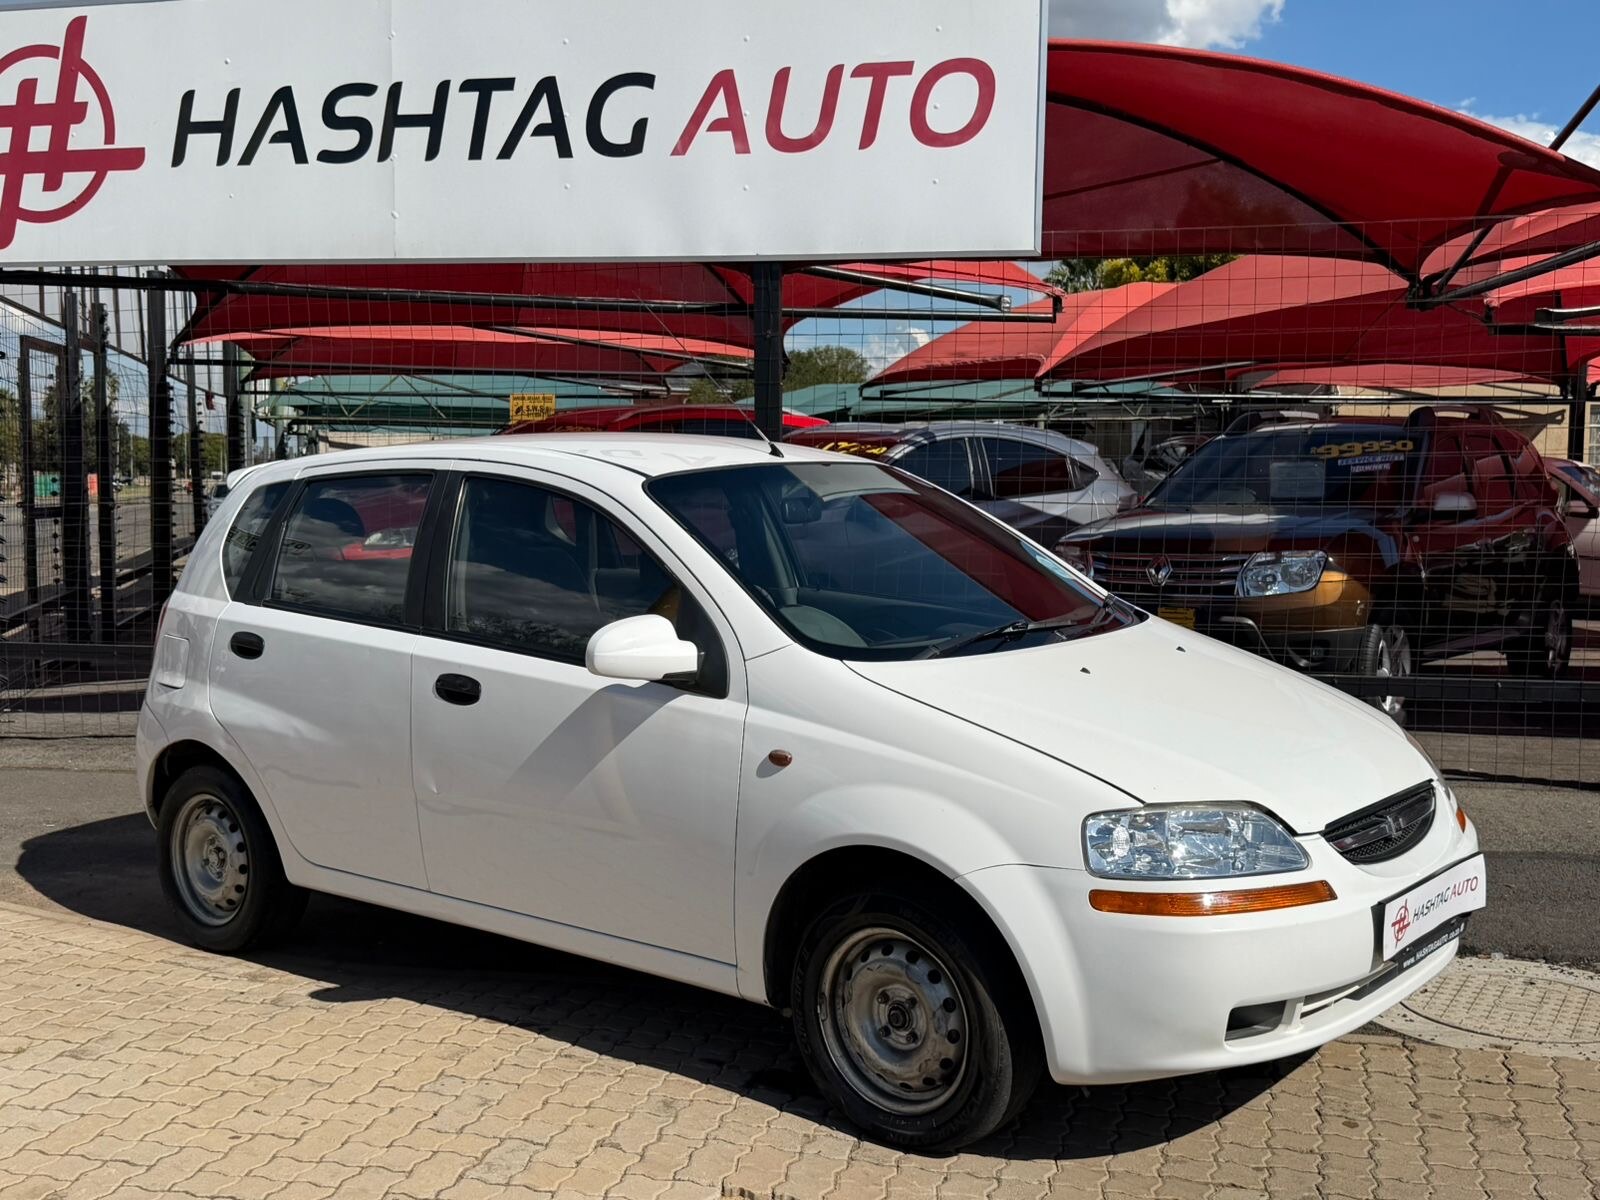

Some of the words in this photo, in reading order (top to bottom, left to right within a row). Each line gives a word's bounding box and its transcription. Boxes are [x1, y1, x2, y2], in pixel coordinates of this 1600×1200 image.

[171, 72, 656, 168] HASHTAG
[670, 57, 996, 156] AUTO
[1413, 887, 1450, 921] HASHTAG
[1451, 876, 1478, 898] AUTO
